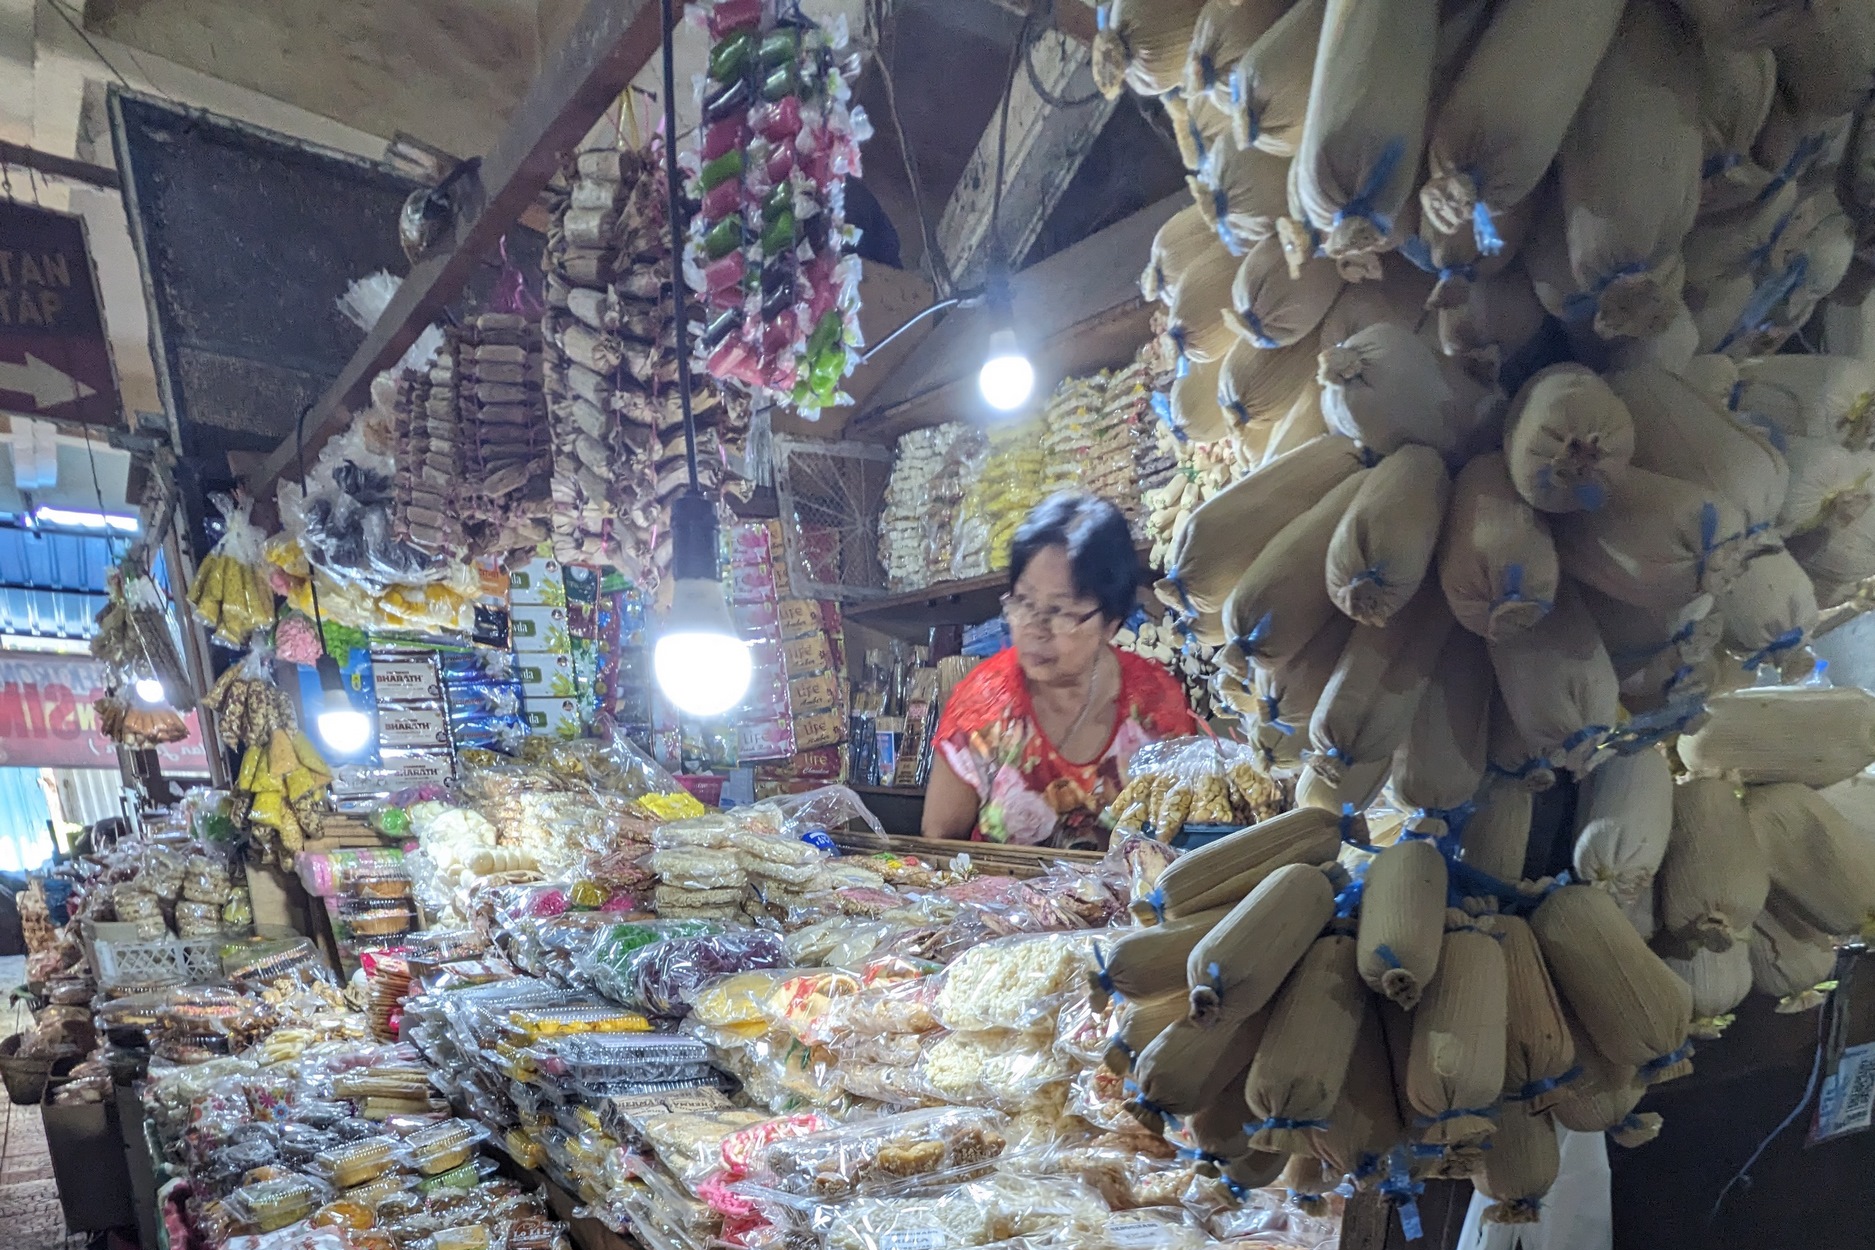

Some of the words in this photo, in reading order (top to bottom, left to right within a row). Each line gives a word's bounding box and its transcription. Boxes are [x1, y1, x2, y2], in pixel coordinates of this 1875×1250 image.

[376, 675, 422, 683] BHARATH
[385, 722, 431, 731] BHARATH
[804, 720, 827, 737] Life
